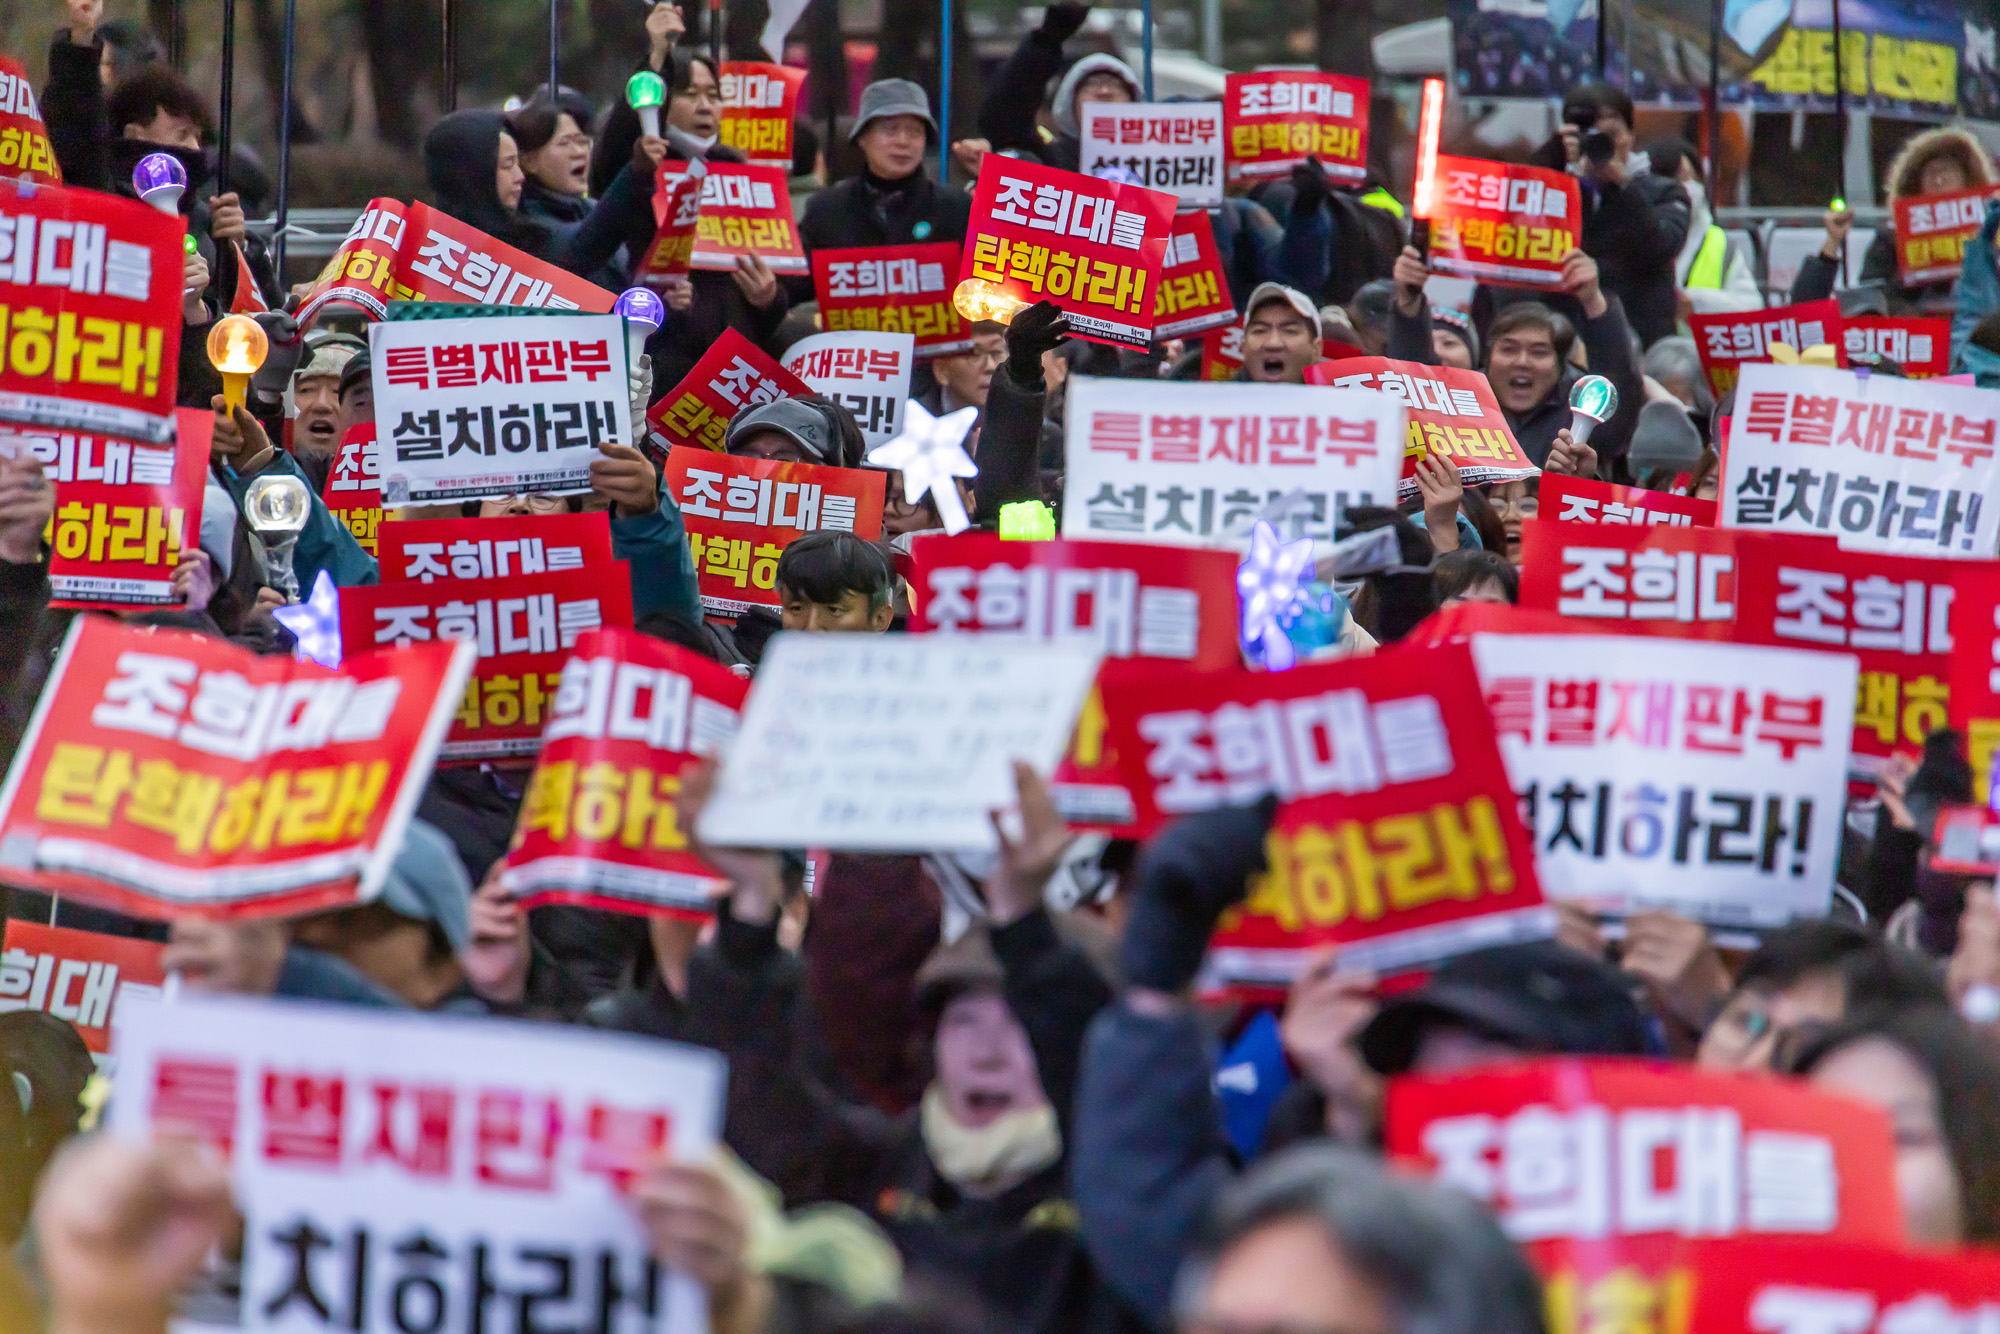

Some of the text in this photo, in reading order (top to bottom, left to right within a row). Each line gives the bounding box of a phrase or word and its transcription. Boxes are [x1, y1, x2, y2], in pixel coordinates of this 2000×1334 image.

[1092, 117, 1216, 145] 특별재판부
[1240, 81, 1354, 118] 조희대를
[1232, 121, 1361, 159] 탄핵하라!
[991, 176, 1146, 250] 조희대를
[1445, 170, 1567, 218] 조희대를
[829, 258, 945, 297] 조희대를
[973, 233, 1147, 314] 탄핵하라!
[0, 302, 163, 397] 하라!
[386, 340, 611, 390] 특별재판부
[0, 428, 175, 485] 희대를
[393, 400, 617, 462] 설치하라!
[1090, 412, 1378, 467] 특별재판부
[1746, 392, 1996, 468] 특별재판부
[44, 501, 184, 565] 하라!
[680, 467, 856, 533] 조희대를
[1736, 466, 1984, 551] 설치하라!
[716, 599, 752, 611] 국민주권실
[92, 651, 402, 761] 조희대를
[1486, 675, 1825, 762] 특별재판부
[1138, 686, 1454, 813] 조희대를
[36, 741, 391, 855] 탄핵하라!
[1517, 779, 1816, 879] 치하라!
[1, 948, 162, 1028] 희대
[181, 1217, 660, 1334] 치하라!
